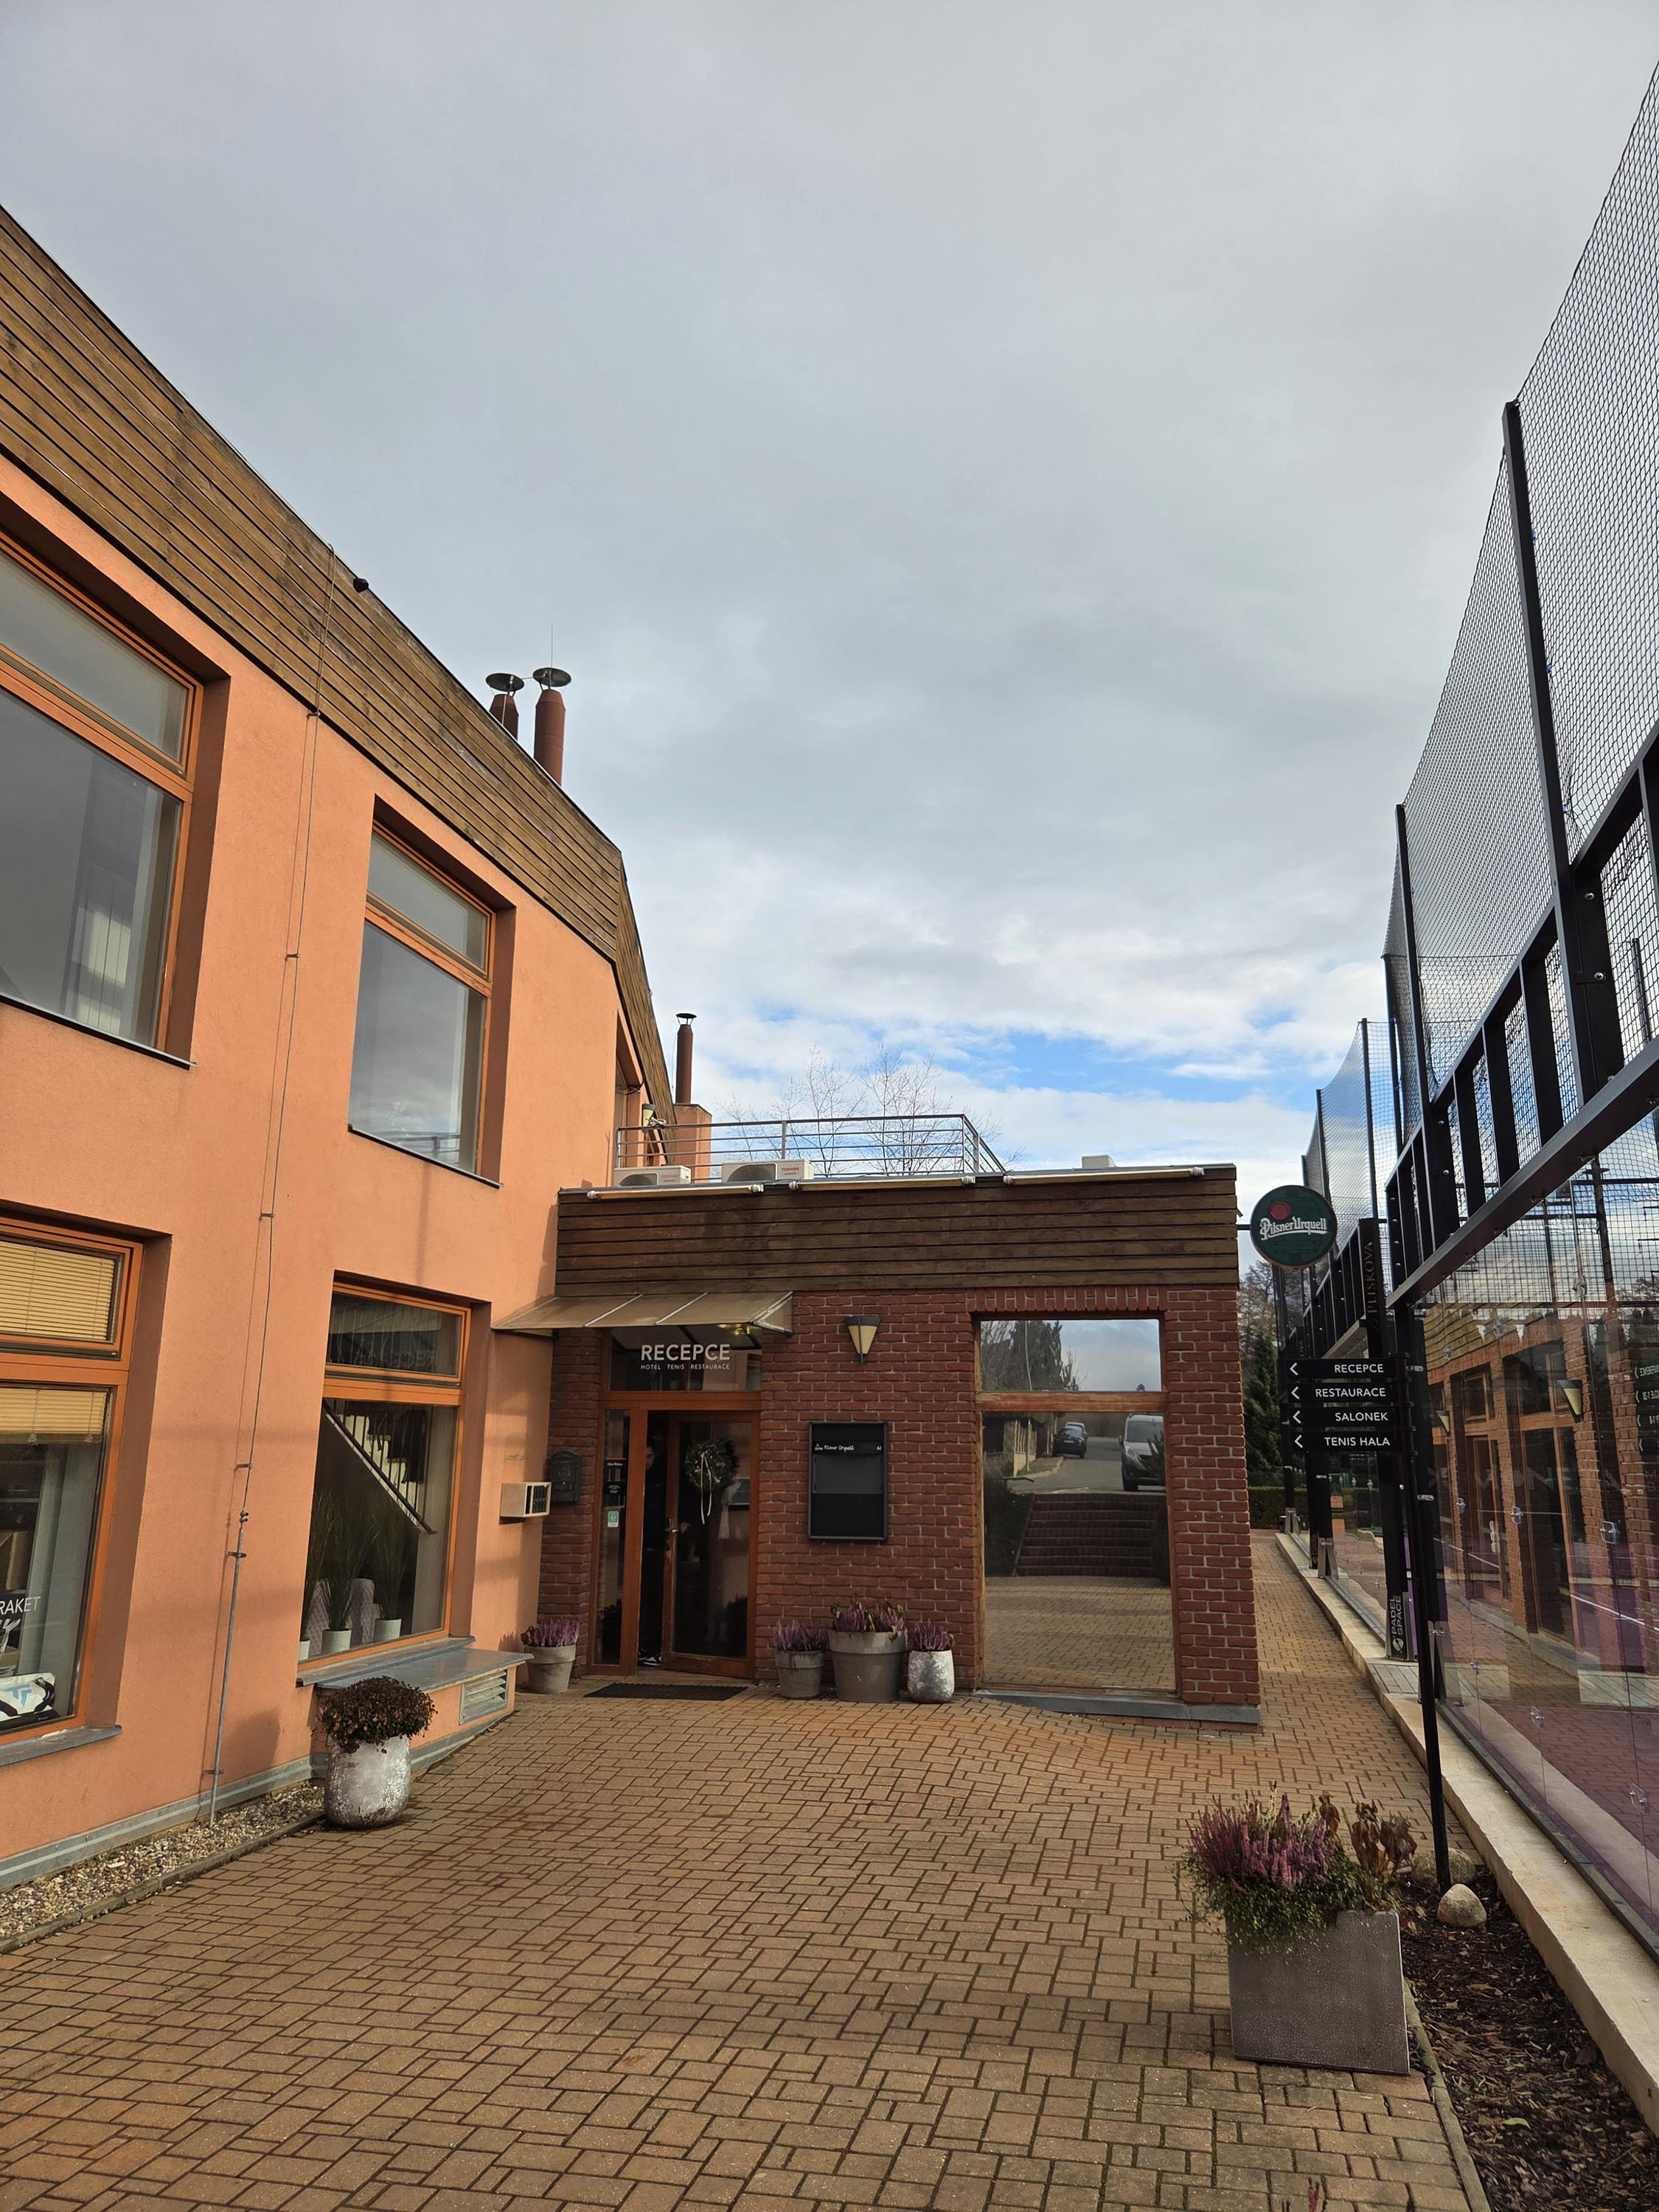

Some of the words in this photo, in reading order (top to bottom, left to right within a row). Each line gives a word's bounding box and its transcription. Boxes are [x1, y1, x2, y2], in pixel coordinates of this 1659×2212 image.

[1259, 1217, 1293, 1240] Pilsner
[1293, 1216, 1326, 1235] Urquell
[641, 1343, 730, 1360] RECEPCE
[1334, 1363, 1384, 1373] RECEPCE
[1315, 1388, 1386, 1397] RESTAURACE
[1335, 1412, 1388, 1422] SALONEK
[1324, 1437, 1357, 1446] TENIS
[1360, 1437, 1391, 1446] HALA
[0, 1596, 41, 1615] RAKET
[1395, 1595, 1403, 1636] SPACE
